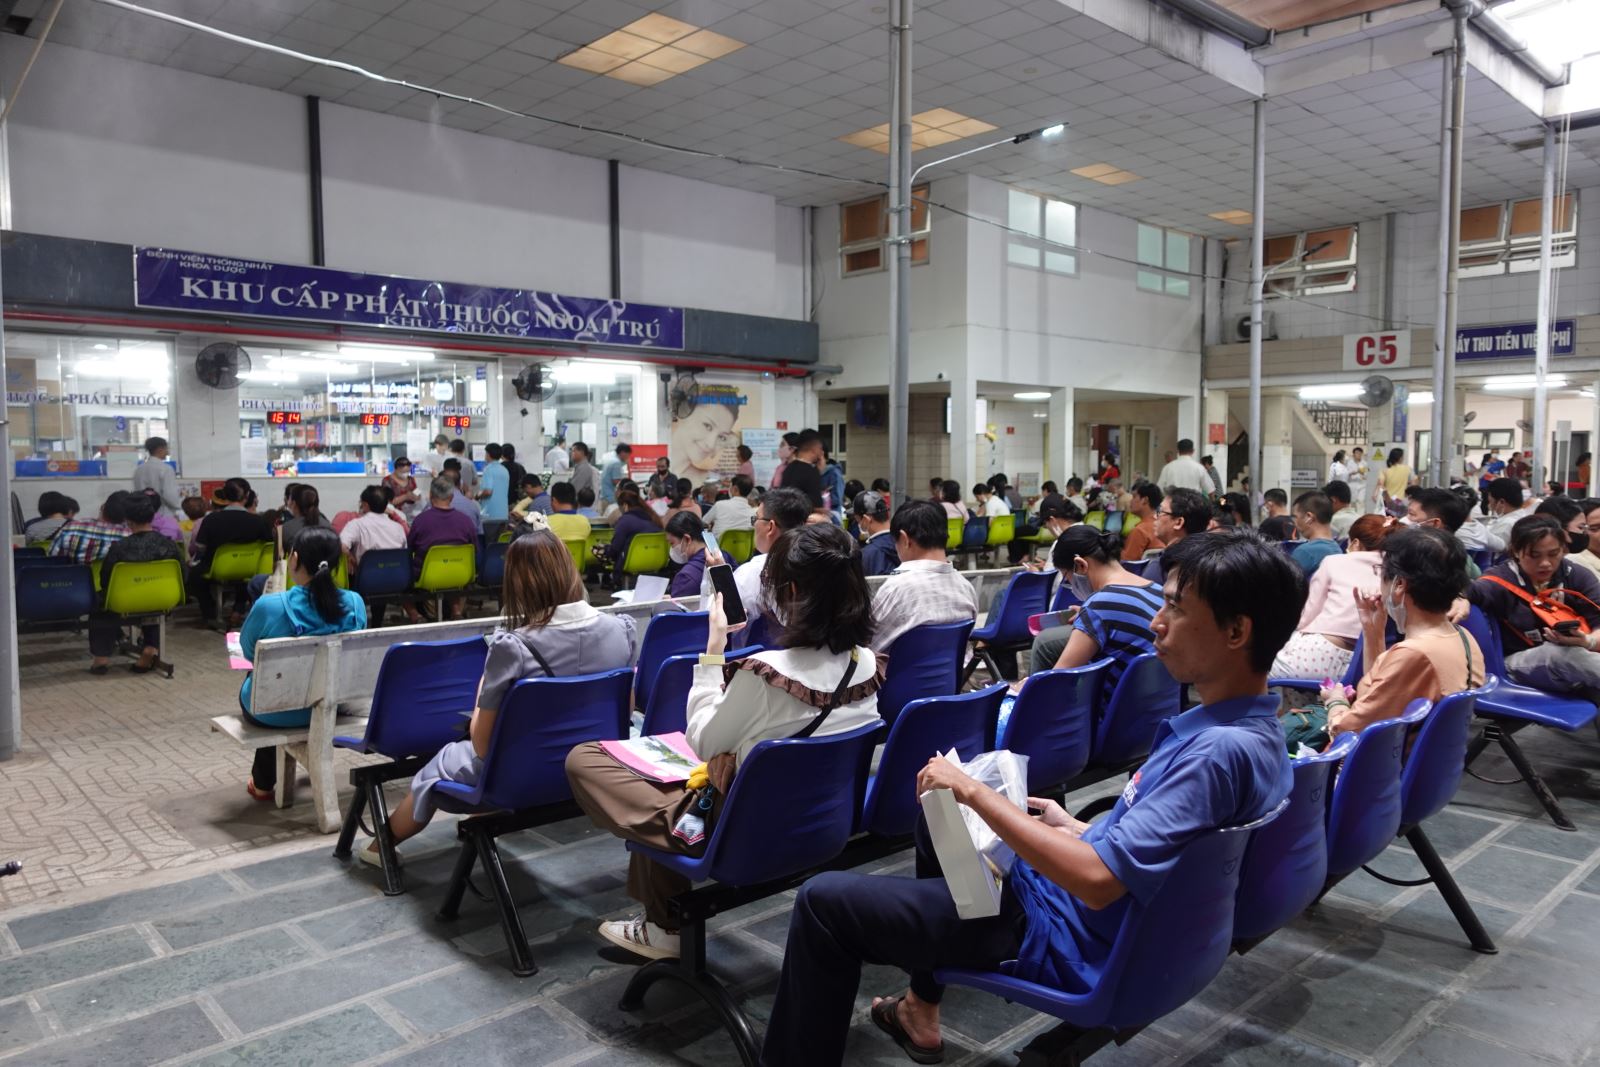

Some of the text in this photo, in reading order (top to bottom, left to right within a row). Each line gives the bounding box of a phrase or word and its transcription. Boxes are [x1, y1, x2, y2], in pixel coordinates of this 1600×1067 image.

[180, 261, 211, 271] KHOA
[181, 276, 266, 304] KHU
[271, 280, 340, 310] CẤP
[344, 292, 428, 318] PHÁT
[433, 301, 531, 327] THUỐC
[615, 318, 661, 339] TRÚ
[384, 315, 432, 328] KHU
[1455, 333, 1470, 353] ẤY
[1472, 335, 1493, 353] THU
[1522, 329, 1539, 352] VIỆ
[1356, 335, 1397, 366] C5
[68, 391, 167, 407] PHÁT THUỐC
[561, 425, 568, 437] 7
[612, 426, 618, 437] 8
